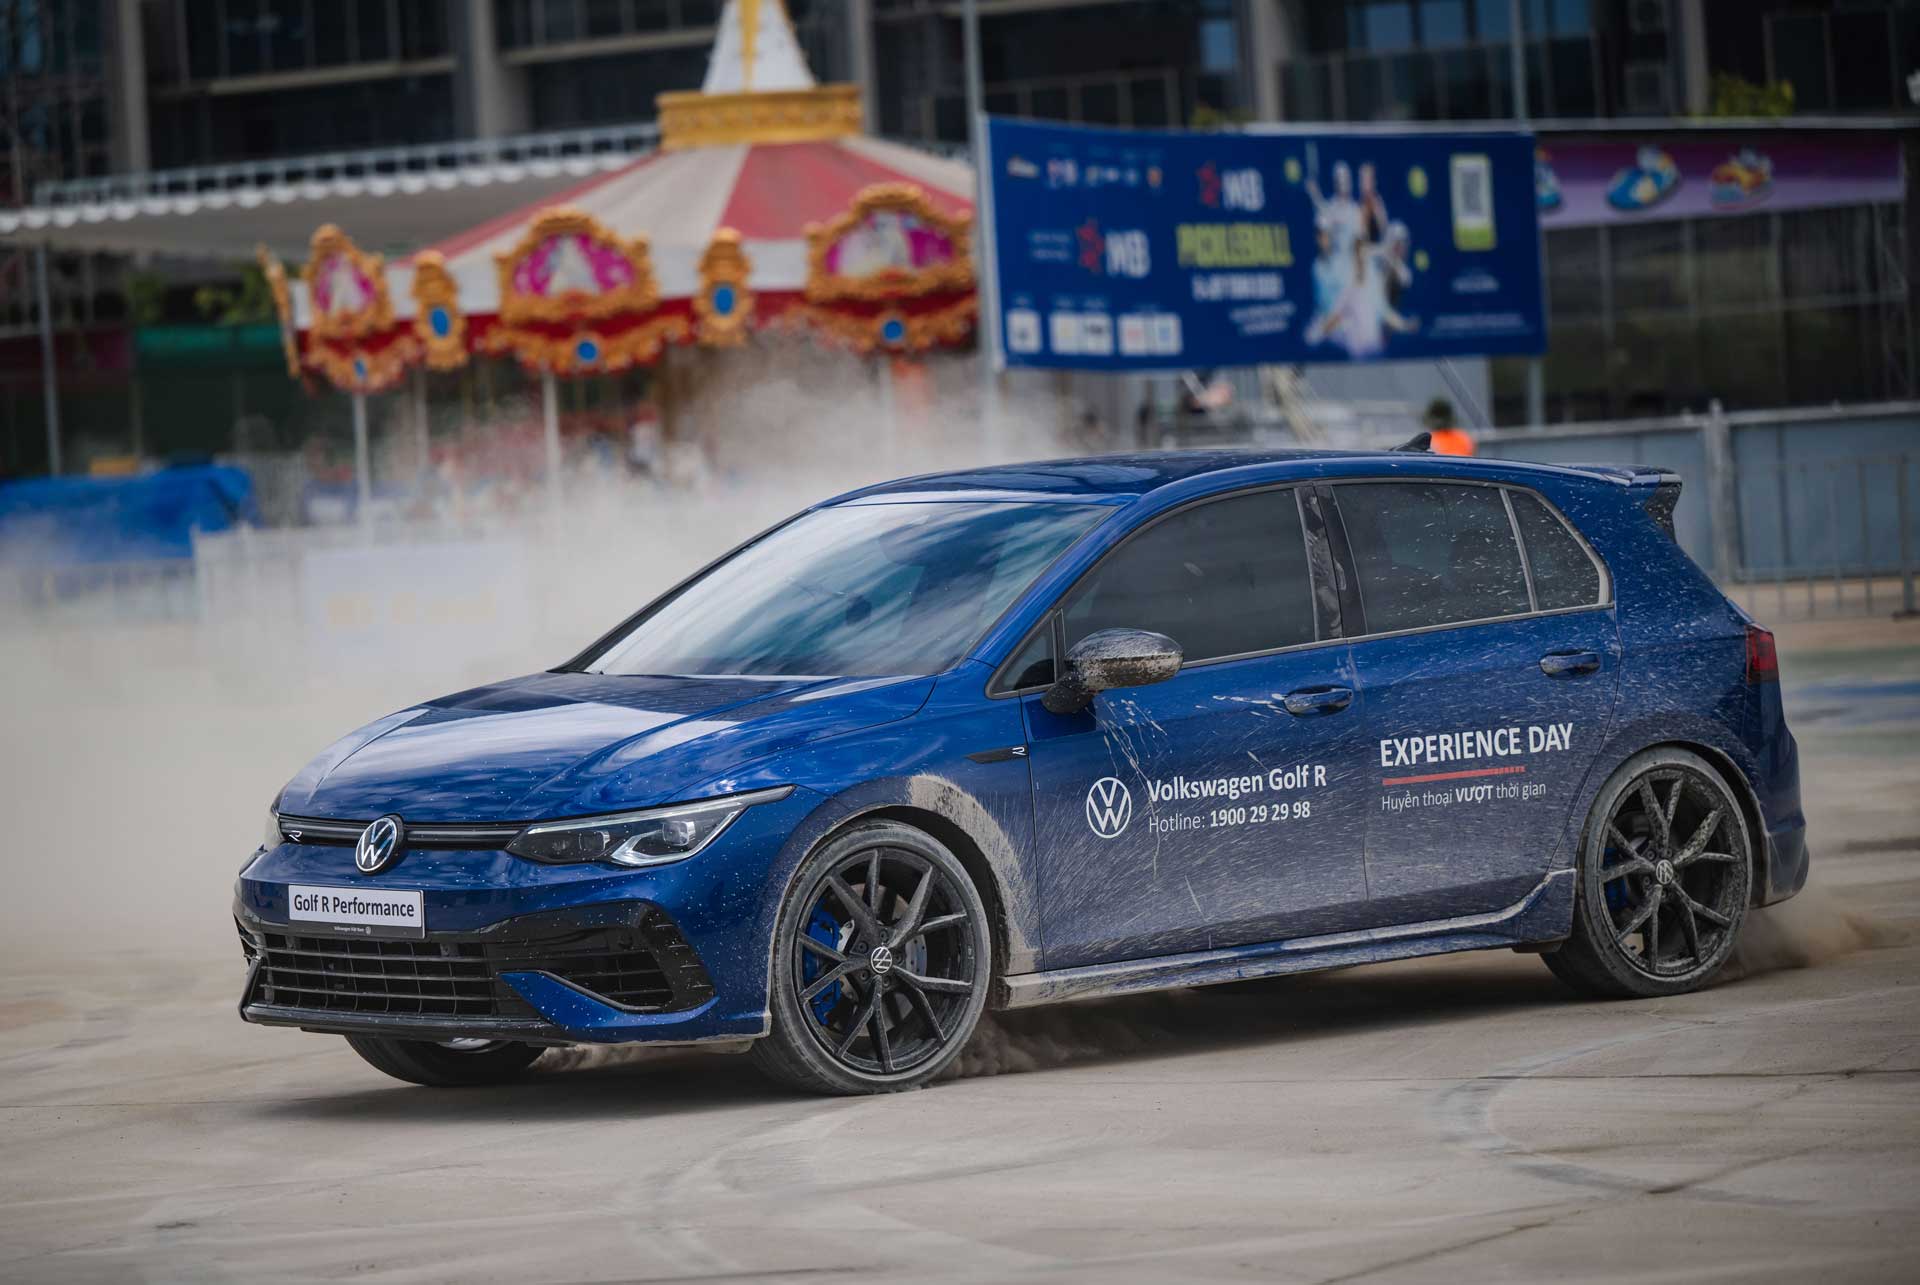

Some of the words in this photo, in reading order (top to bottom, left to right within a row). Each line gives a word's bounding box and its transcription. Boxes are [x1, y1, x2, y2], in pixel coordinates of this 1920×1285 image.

[1105, 229, 1150, 278] MB
[1380, 727, 1522, 767] EXPERIENCE
[1528, 722, 1574, 753] DAY
[1148, 775, 1264, 802] Volkswagen
[1268, 765, 1309, 791] Golf
[1314, 765, 1327, 787] R
[1381, 790, 1420, 813] Huyền
[1422, 789, 1453, 809] thoại
[1455, 785, 1494, 804] VƯỢT
[1496, 783, 1519, 800] thời
[1522, 782, 1546, 801] gian
[1149, 813, 1205, 834] Hotline:
[1210, 807, 1246, 828] 1900
[1250, 805, 1268, 824] 29
[1271, 803, 1289, 821] 29
[1293, 801, 1311, 819] 98
[294, 894, 319, 912] Golf
[322, 896, 330, 912] R
[333, 896, 415, 917] Performance
